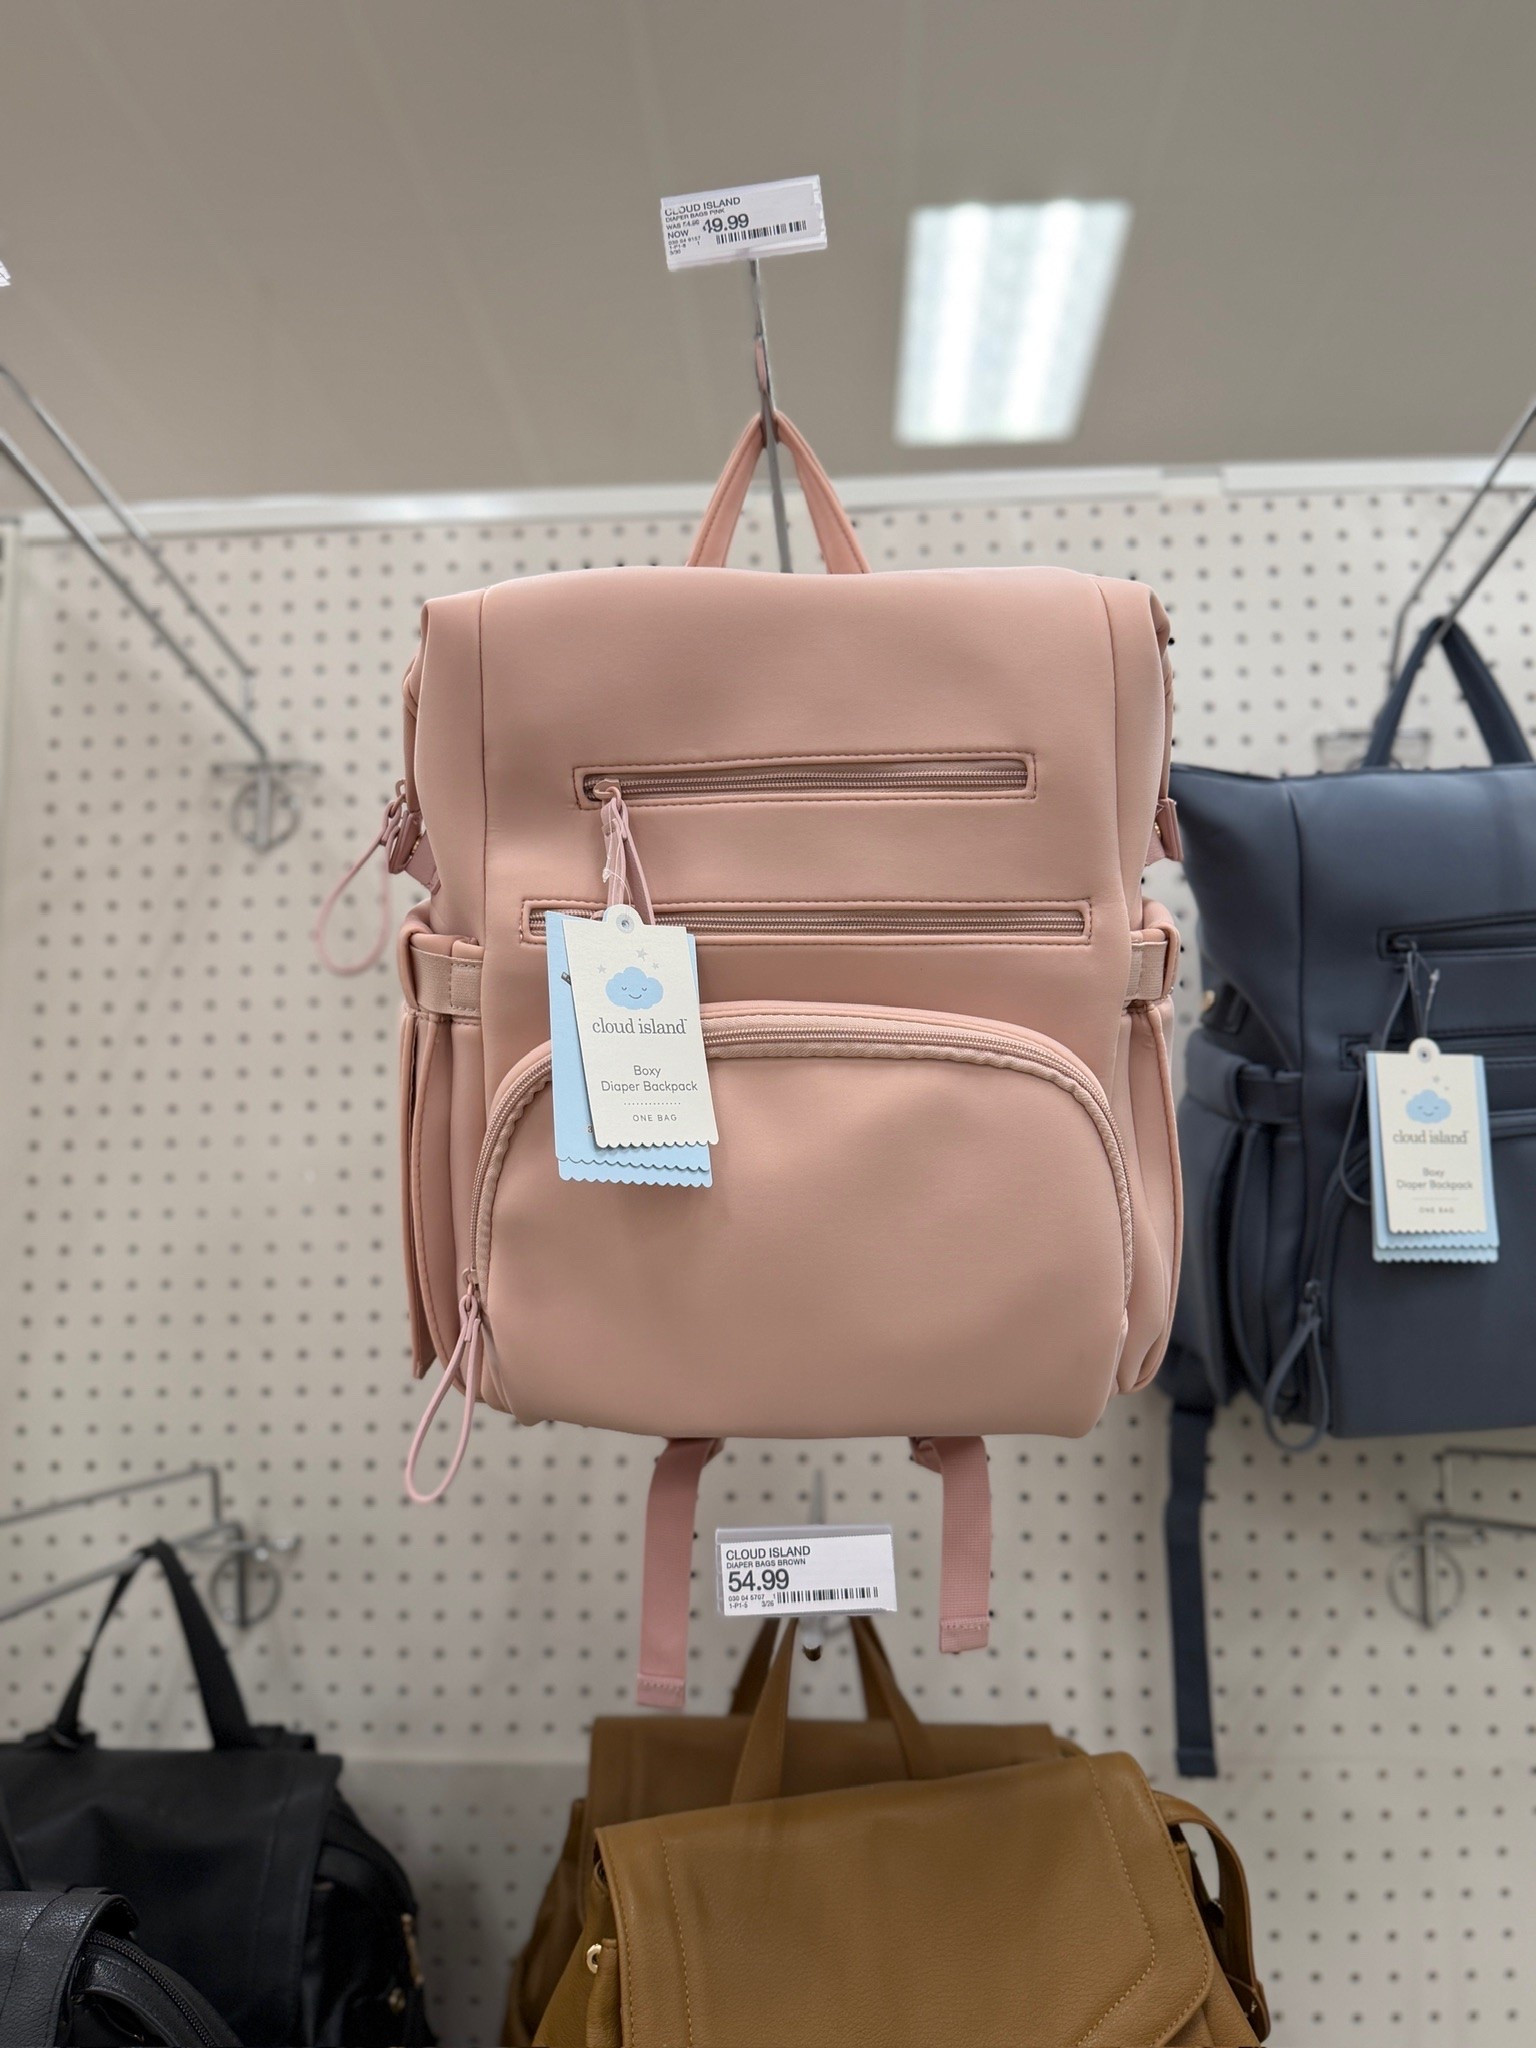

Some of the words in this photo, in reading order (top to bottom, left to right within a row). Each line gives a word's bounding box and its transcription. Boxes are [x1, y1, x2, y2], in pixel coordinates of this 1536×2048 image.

[665, 204, 701, 216] CLOUD
[703, 197, 741, 210] ISLAND
[665, 214, 689, 223] DIAPER
[667, 230, 689, 239] NOW
[703, 213, 749, 233] 49.99
[592, 1018, 635, 1034] cloud
[638, 1018, 685, 1035] island
[633, 1065, 662, 1079] Boxy
[601, 1081, 640, 1094] Diaper
[643, 1081, 698, 1094] Backpack
[632, 1114, 653, 1122] ONE
[657, 1114, 677, 1122] BAG
[1393, 1130, 1426, 1144] cloud
[1429, 1131, 1467, 1144] island
[1422, 1168, 1444, 1178] Boxy
[1396, 1180, 1427, 1191] Diaper
[1429, 1181, 1473, 1191] Backpack
[726, 1548, 766, 1561] CLOUD
[769, 1545, 811, 1558] ISLAND
[726, 1561, 753, 1569] DIAPER
[778, 1558, 806, 1566] BROWN
[728, 1568, 789, 1592] 54.99
